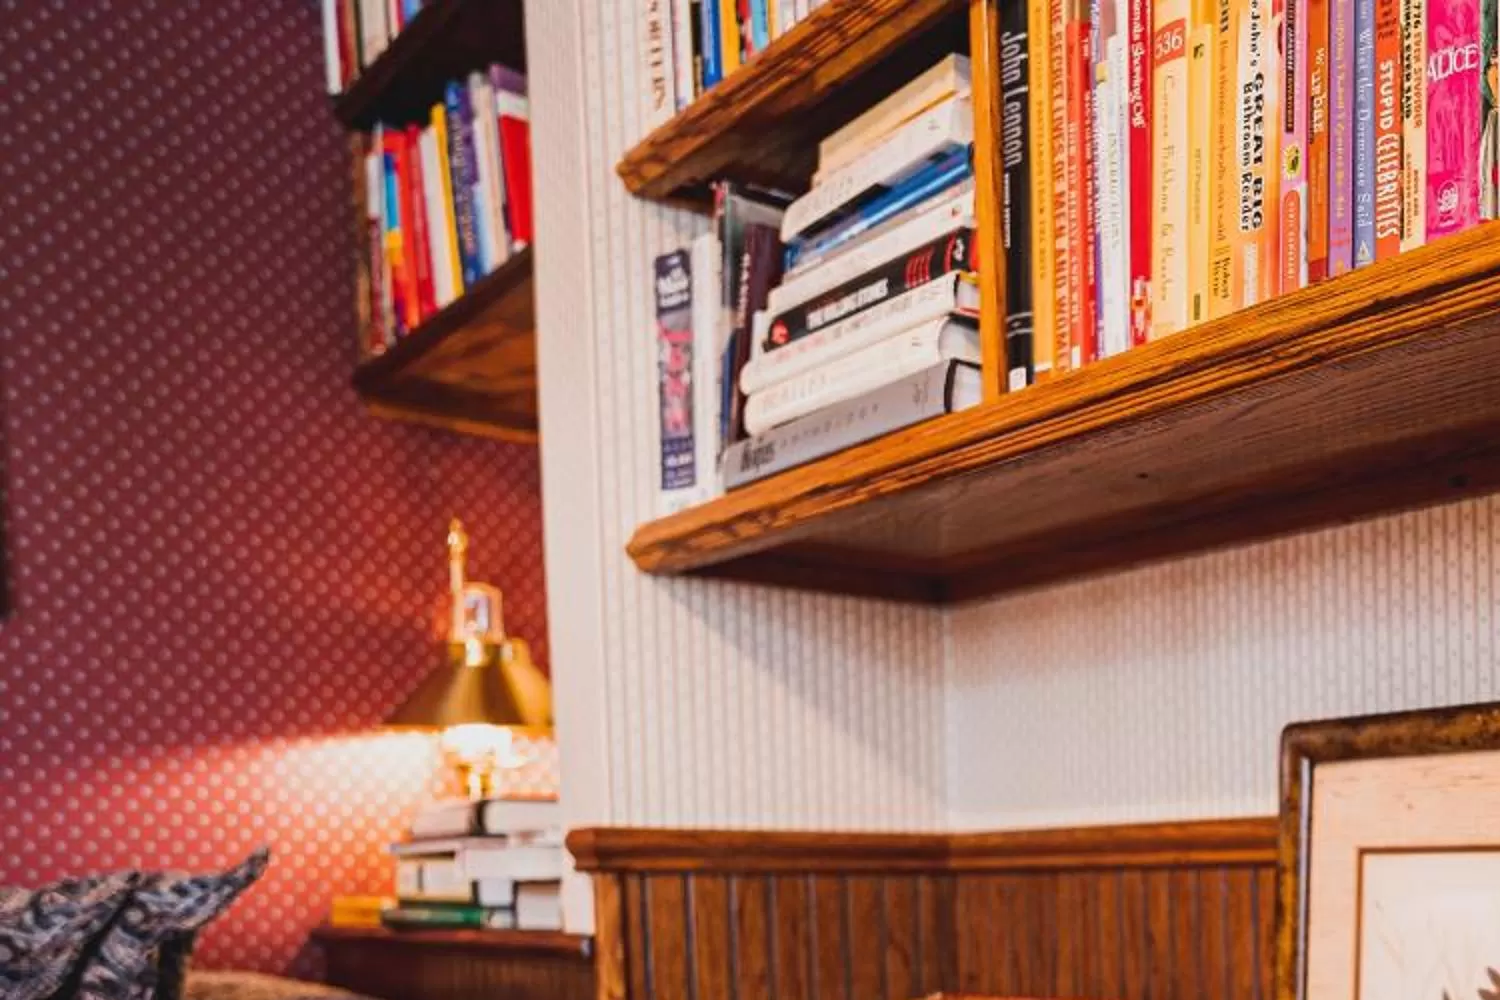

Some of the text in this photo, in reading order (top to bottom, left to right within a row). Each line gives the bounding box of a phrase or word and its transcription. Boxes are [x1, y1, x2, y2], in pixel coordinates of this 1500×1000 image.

[1050, 0, 1062, 25] HE
[1155, 29, 1184, 62] 536
[1250, 12, 1261, 67] John's
[1359, 28, 1373, 73] What
[1427, 43, 1479, 82] ALICE
[1051, 32, 1064, 100] SECRET
[1129, 42, 1145, 103] Showing
[1359, 77, 1373, 103] the
[1001, 32, 1029, 168] John Lennon
[1133, 102, 1147, 128] Off
[1252, 72, 1264, 164] GREAT
[1380, 60, 1395, 130] STUPID
[1413, 68, 1423, 128] STUPIDER
[1053, 107, 1065, 154] LIVES
[1358, 109, 1371, 187] Dormouse
[1053, 161, 1065, 182] OF
[1241, 82, 1253, 232] Bathroom Reader
[1252, 176, 1264, 230] BIG
[1357, 192, 1372, 228] Said
[1376, 133, 1400, 239] CELEBRITIES
[1055, 190, 1066, 241] MEN
[1056, 249, 1067, 289] AND
